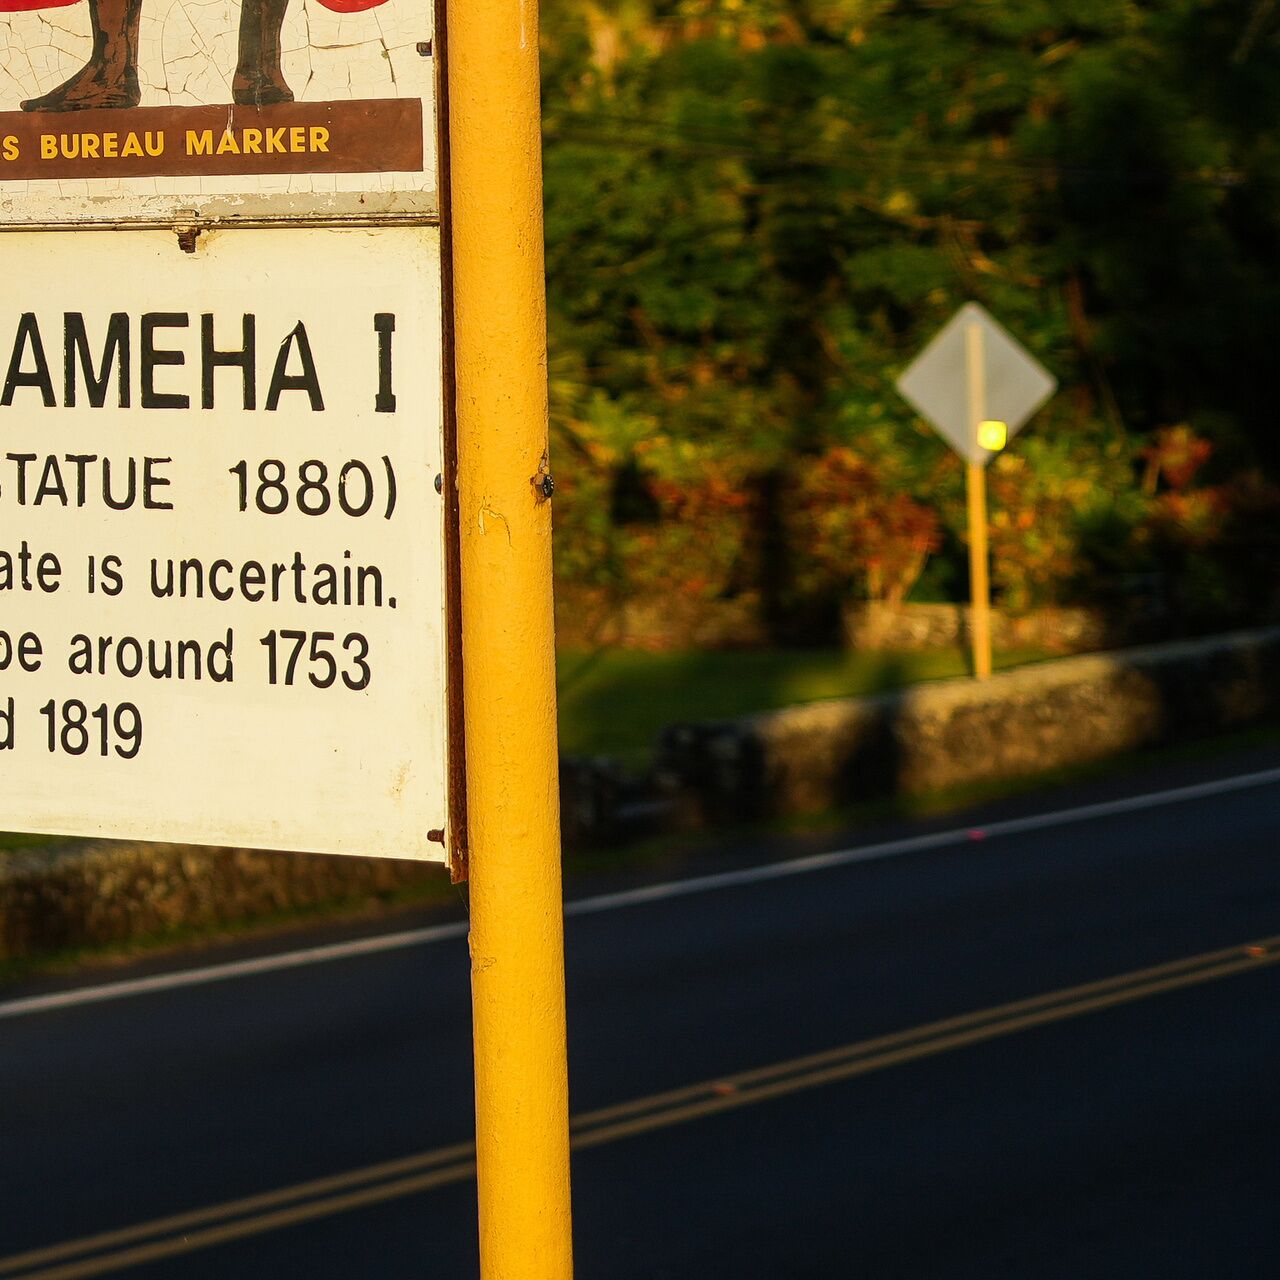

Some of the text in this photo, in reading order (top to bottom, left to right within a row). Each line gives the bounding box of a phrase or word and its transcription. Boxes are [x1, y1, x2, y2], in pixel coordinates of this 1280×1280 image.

[40, 130, 166, 160] BUREAU
[185, 126, 331, 157] MARKER
[373, 311, 398, 414] I
[227, 454, 398, 521] 1880)
[87, 554, 124, 597] is
[68, 627, 235, 684] around
[259, 628, 372, 692] 1753
[38, 697, 143, 761] 1819
